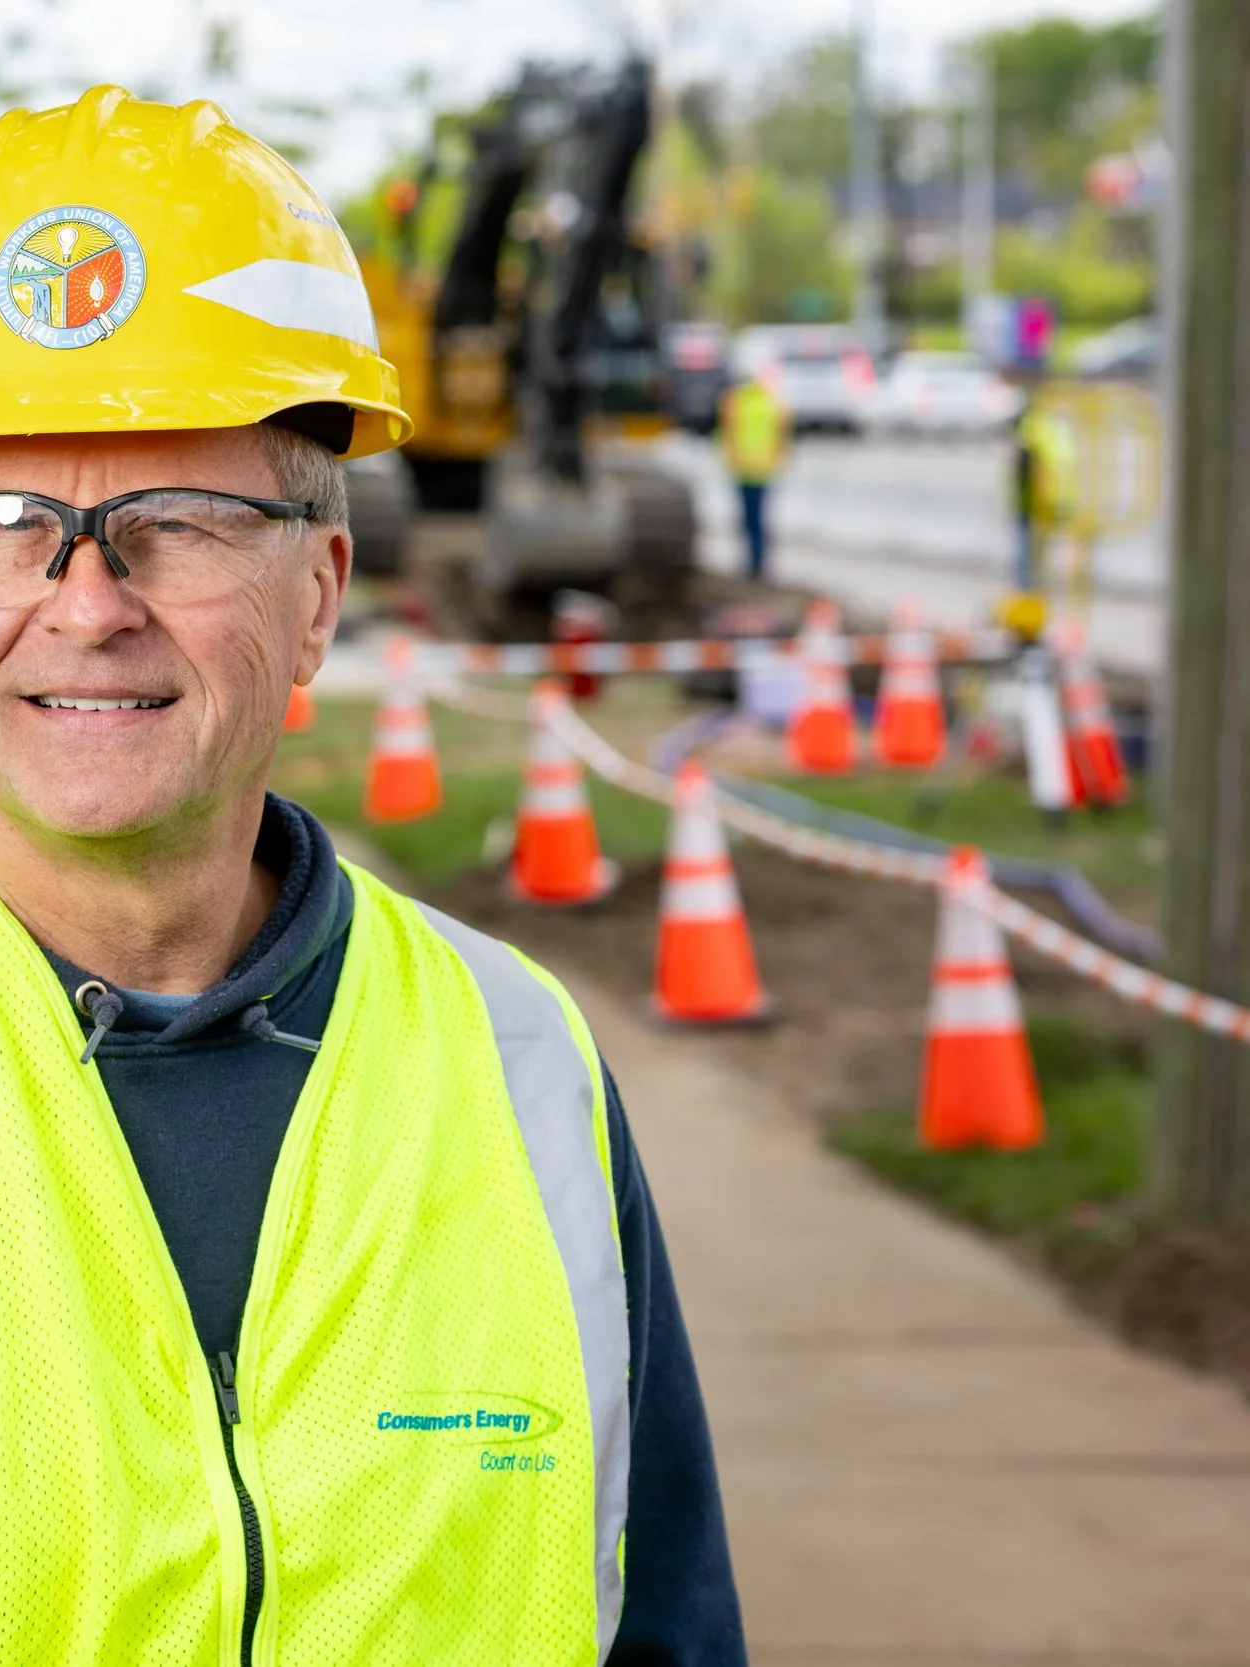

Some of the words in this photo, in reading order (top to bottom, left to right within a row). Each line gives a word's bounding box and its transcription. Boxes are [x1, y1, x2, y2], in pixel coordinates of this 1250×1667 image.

[63, 209, 115, 230] UNION
[0, 211, 57, 270] WORKERS
[115, 229, 132, 247] OF
[114, 252, 141, 319] AMERICA
[377, 1411, 472, 1431] Consumers
[475, 1410, 531, 1432] Energy
[480, 1451, 516, 1471] Count
[518, 1456, 533, 1471] on
[535, 1453, 556, 1472] Us
